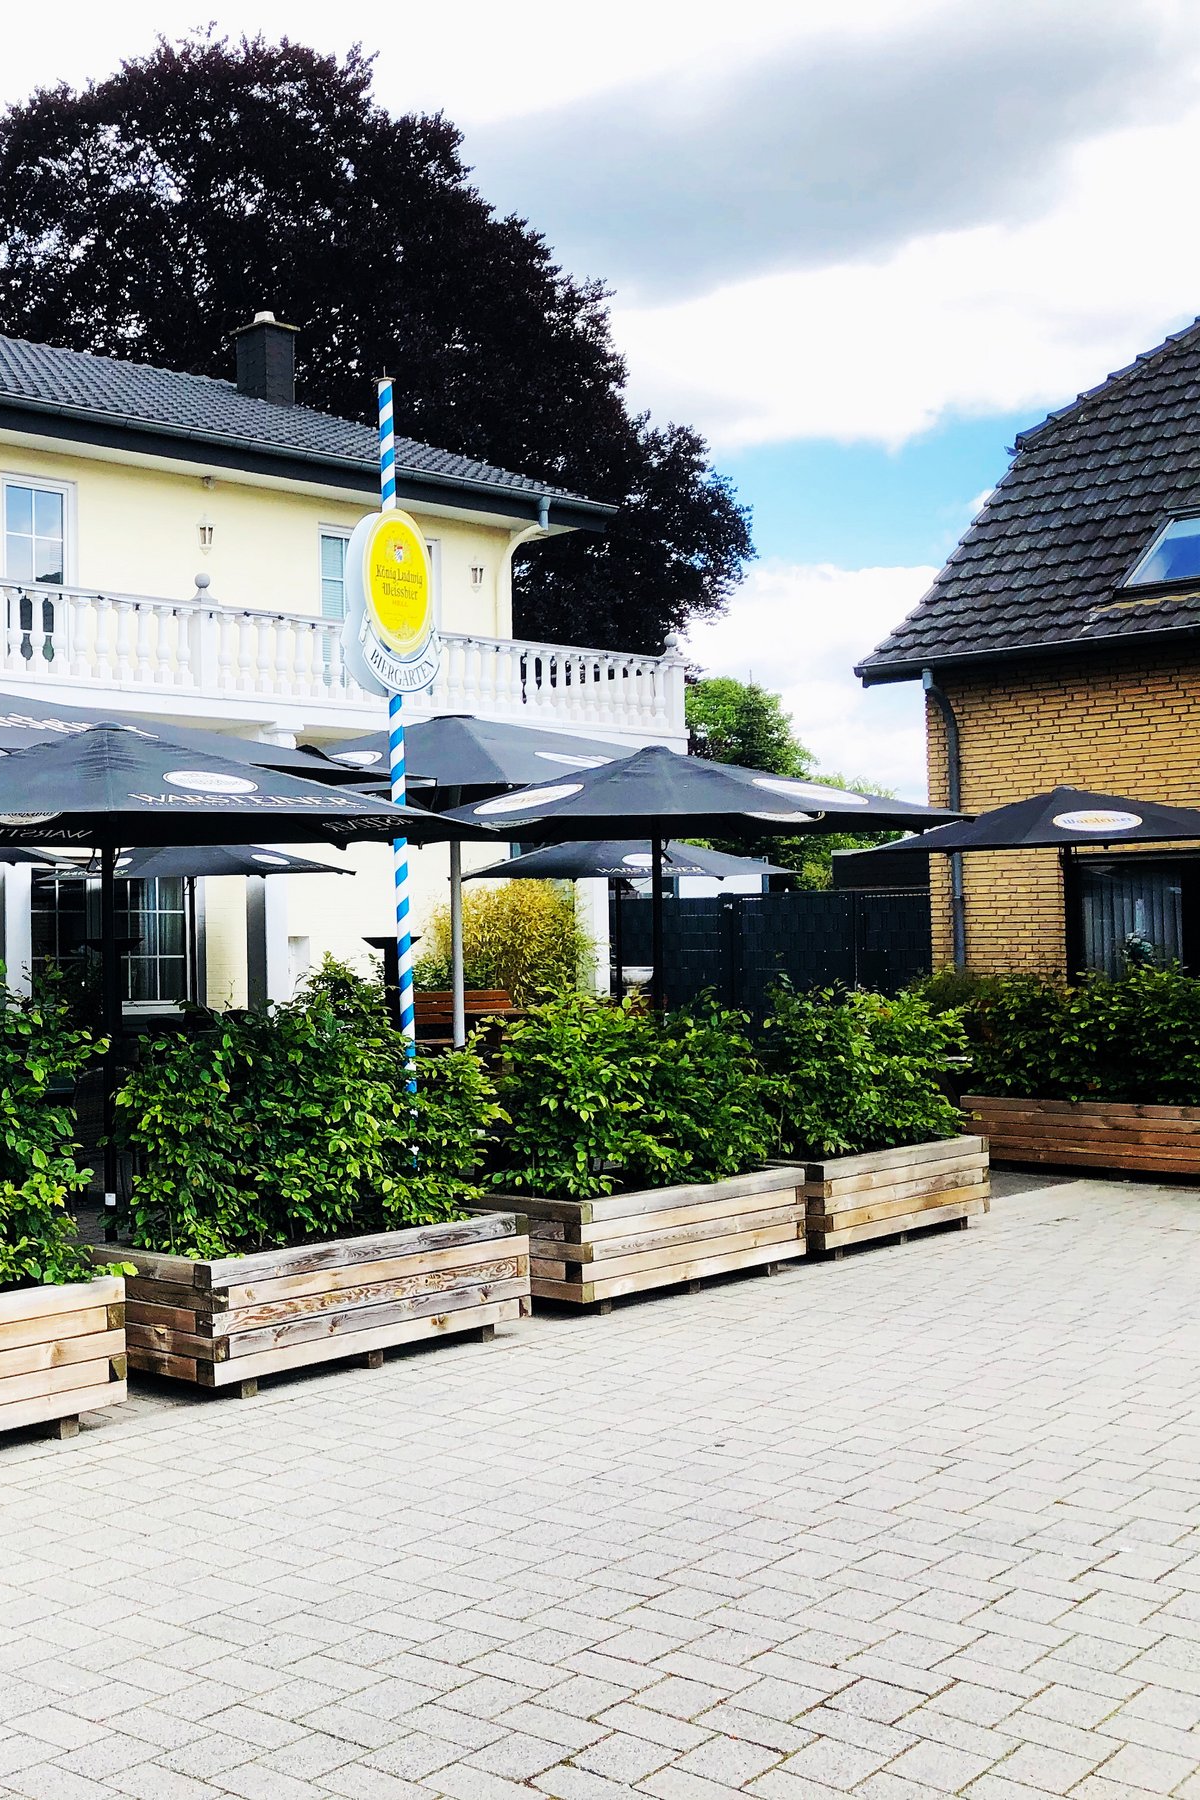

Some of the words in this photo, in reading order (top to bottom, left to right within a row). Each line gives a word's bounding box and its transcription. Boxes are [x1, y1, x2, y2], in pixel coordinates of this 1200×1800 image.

[376, 564, 397, 583] König
[397, 568, 423, 589] Ludwig
[382, 582, 418, 600] Weissbier
[369, 649, 435, 687] BIERGARTEN
[127, 793, 362, 807] WARSTEINER
[596, 866, 707, 874] WARSTINER
